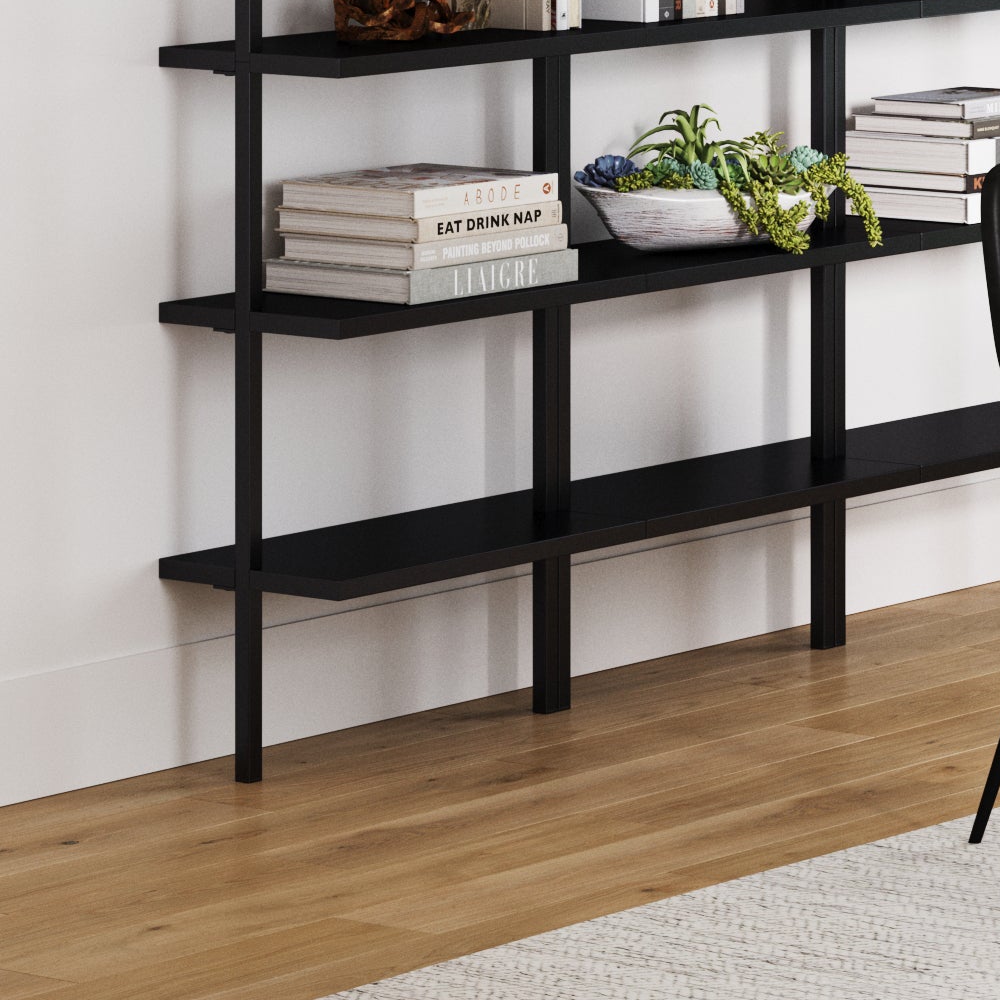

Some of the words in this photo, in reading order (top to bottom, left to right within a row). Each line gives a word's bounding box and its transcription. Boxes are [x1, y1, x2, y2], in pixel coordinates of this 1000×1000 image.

[463, 183, 522, 207] ABODE
[437, 220, 462, 236] EAT
[466, 213, 509, 231] DRINK
[513, 209, 542, 225] NAP
[442, 243, 480, 260] PAINTING
[481, 237, 513, 255] BEYOND
[515, 231, 550, 251] POLLOCK
[453, 257, 539, 297] LIAIGRE
